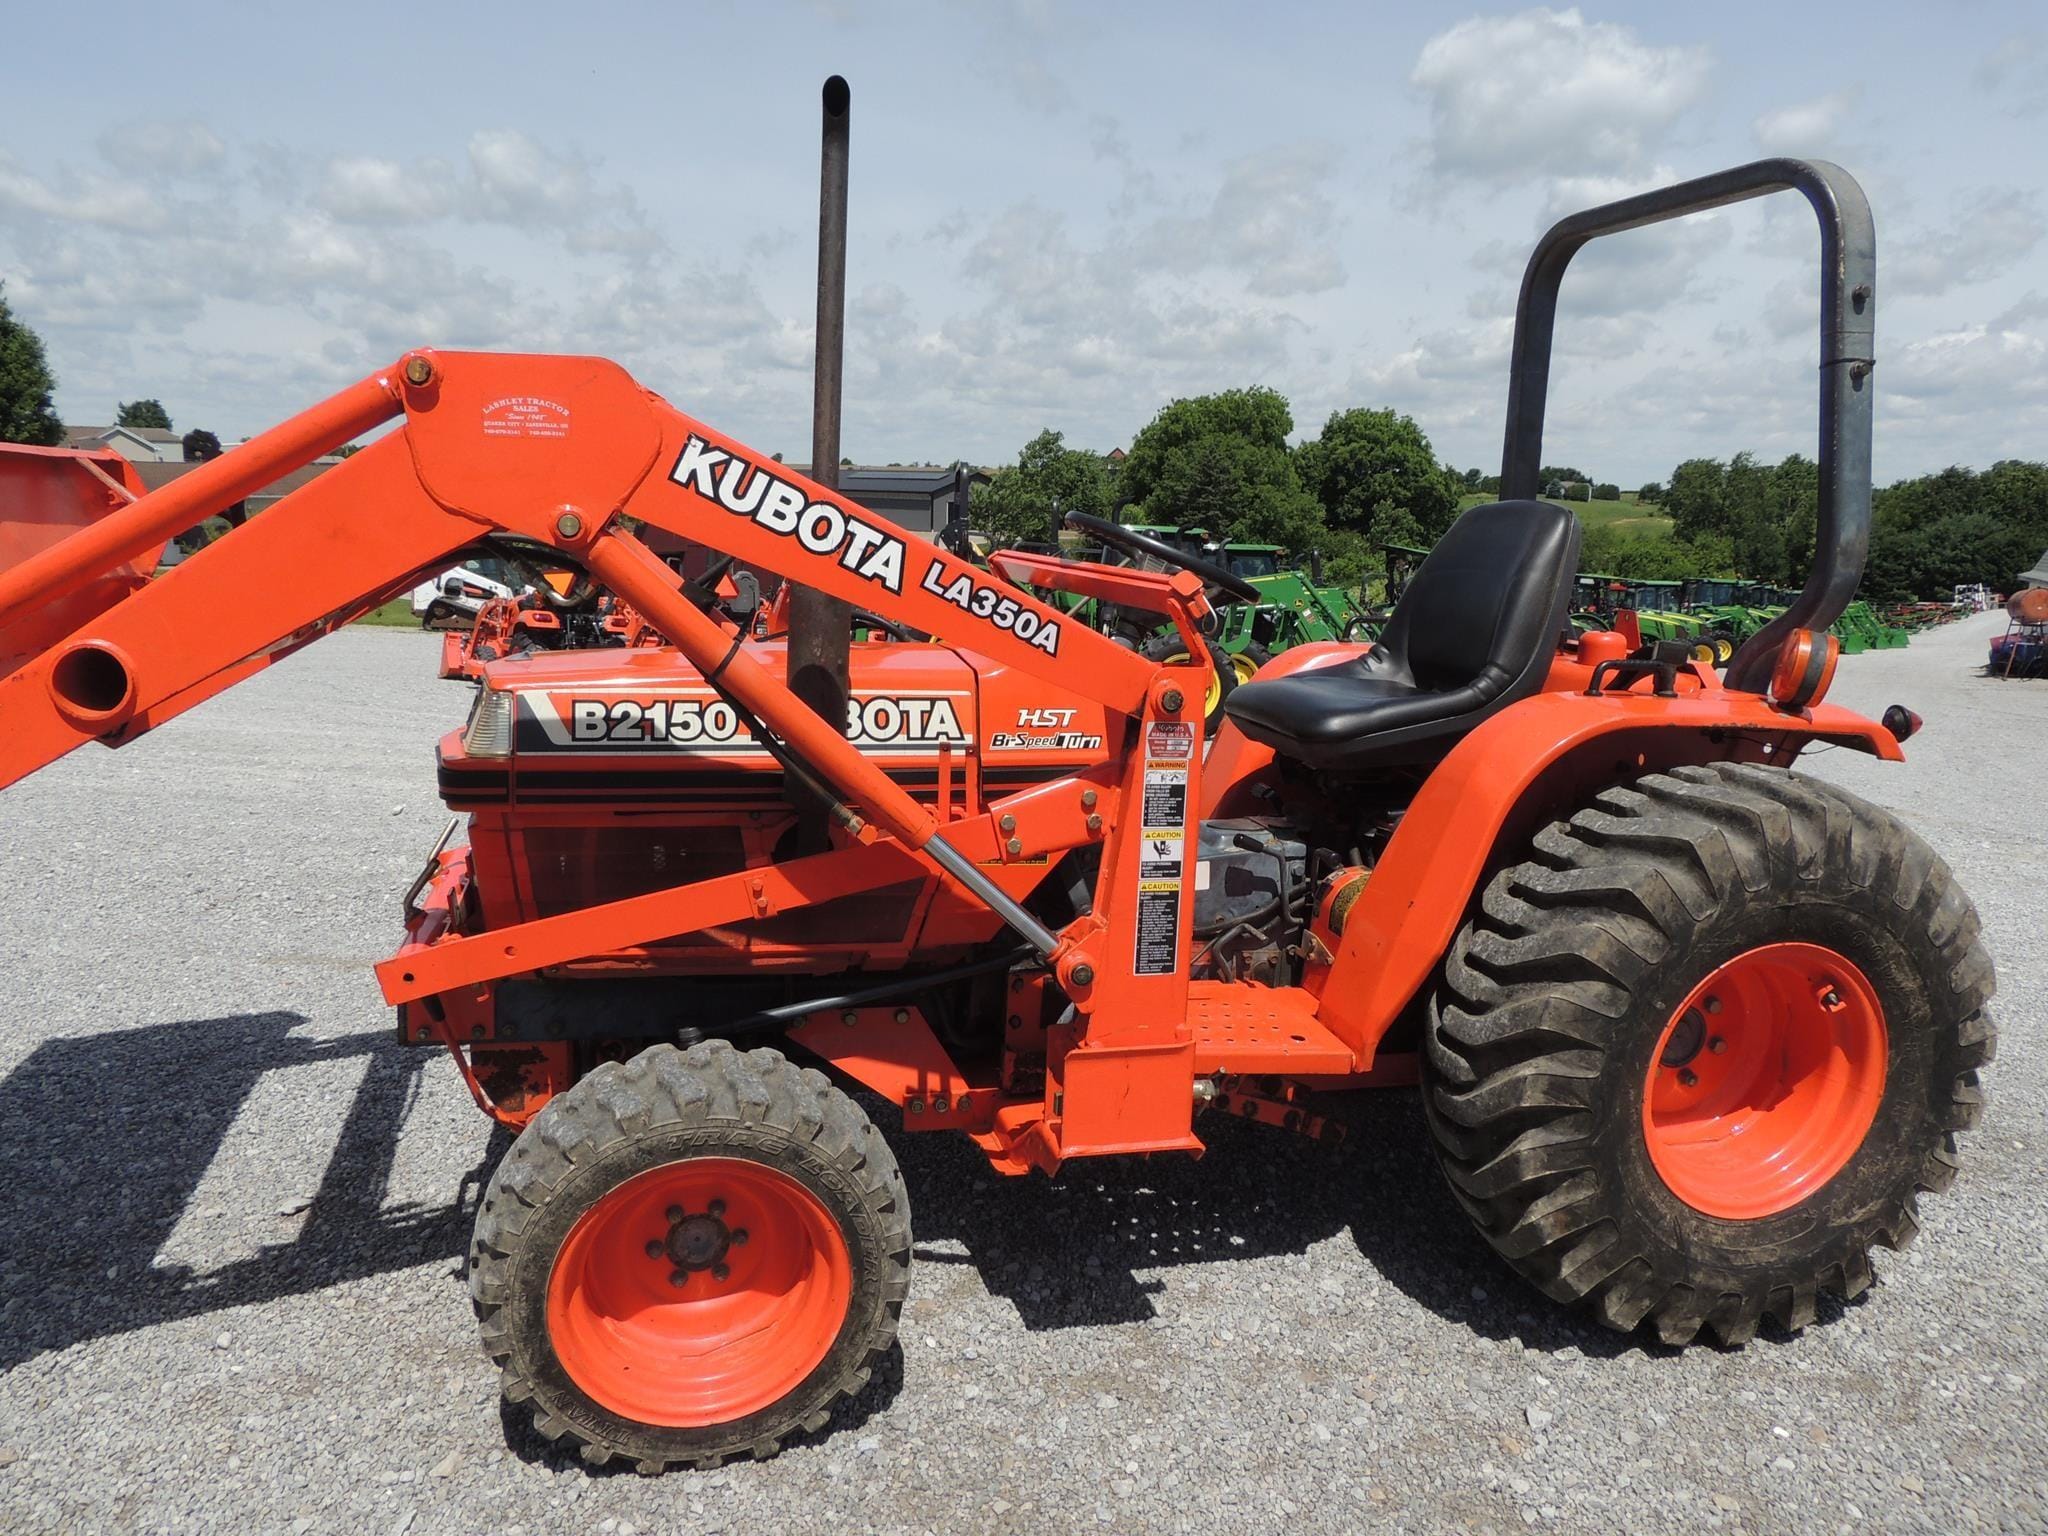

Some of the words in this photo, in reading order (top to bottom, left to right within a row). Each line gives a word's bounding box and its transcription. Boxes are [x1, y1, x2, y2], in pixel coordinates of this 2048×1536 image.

[526, 397, 570, 417] TRACTOR
[670, 433, 907, 596] KUBOTA
[921, 558, 1061, 658] LA350A
[572, 700, 738, 742] B2150
[1016, 708, 1077, 728] HST
[991, 732, 1059, 749] Bi-Speed
[1059, 732, 1102, 749] Turn
[1151, 831, 1181, 839] CAUTION
[666, 1129, 790, 1155] TRAC
[551, 1390, 633, 1446] TITAN
